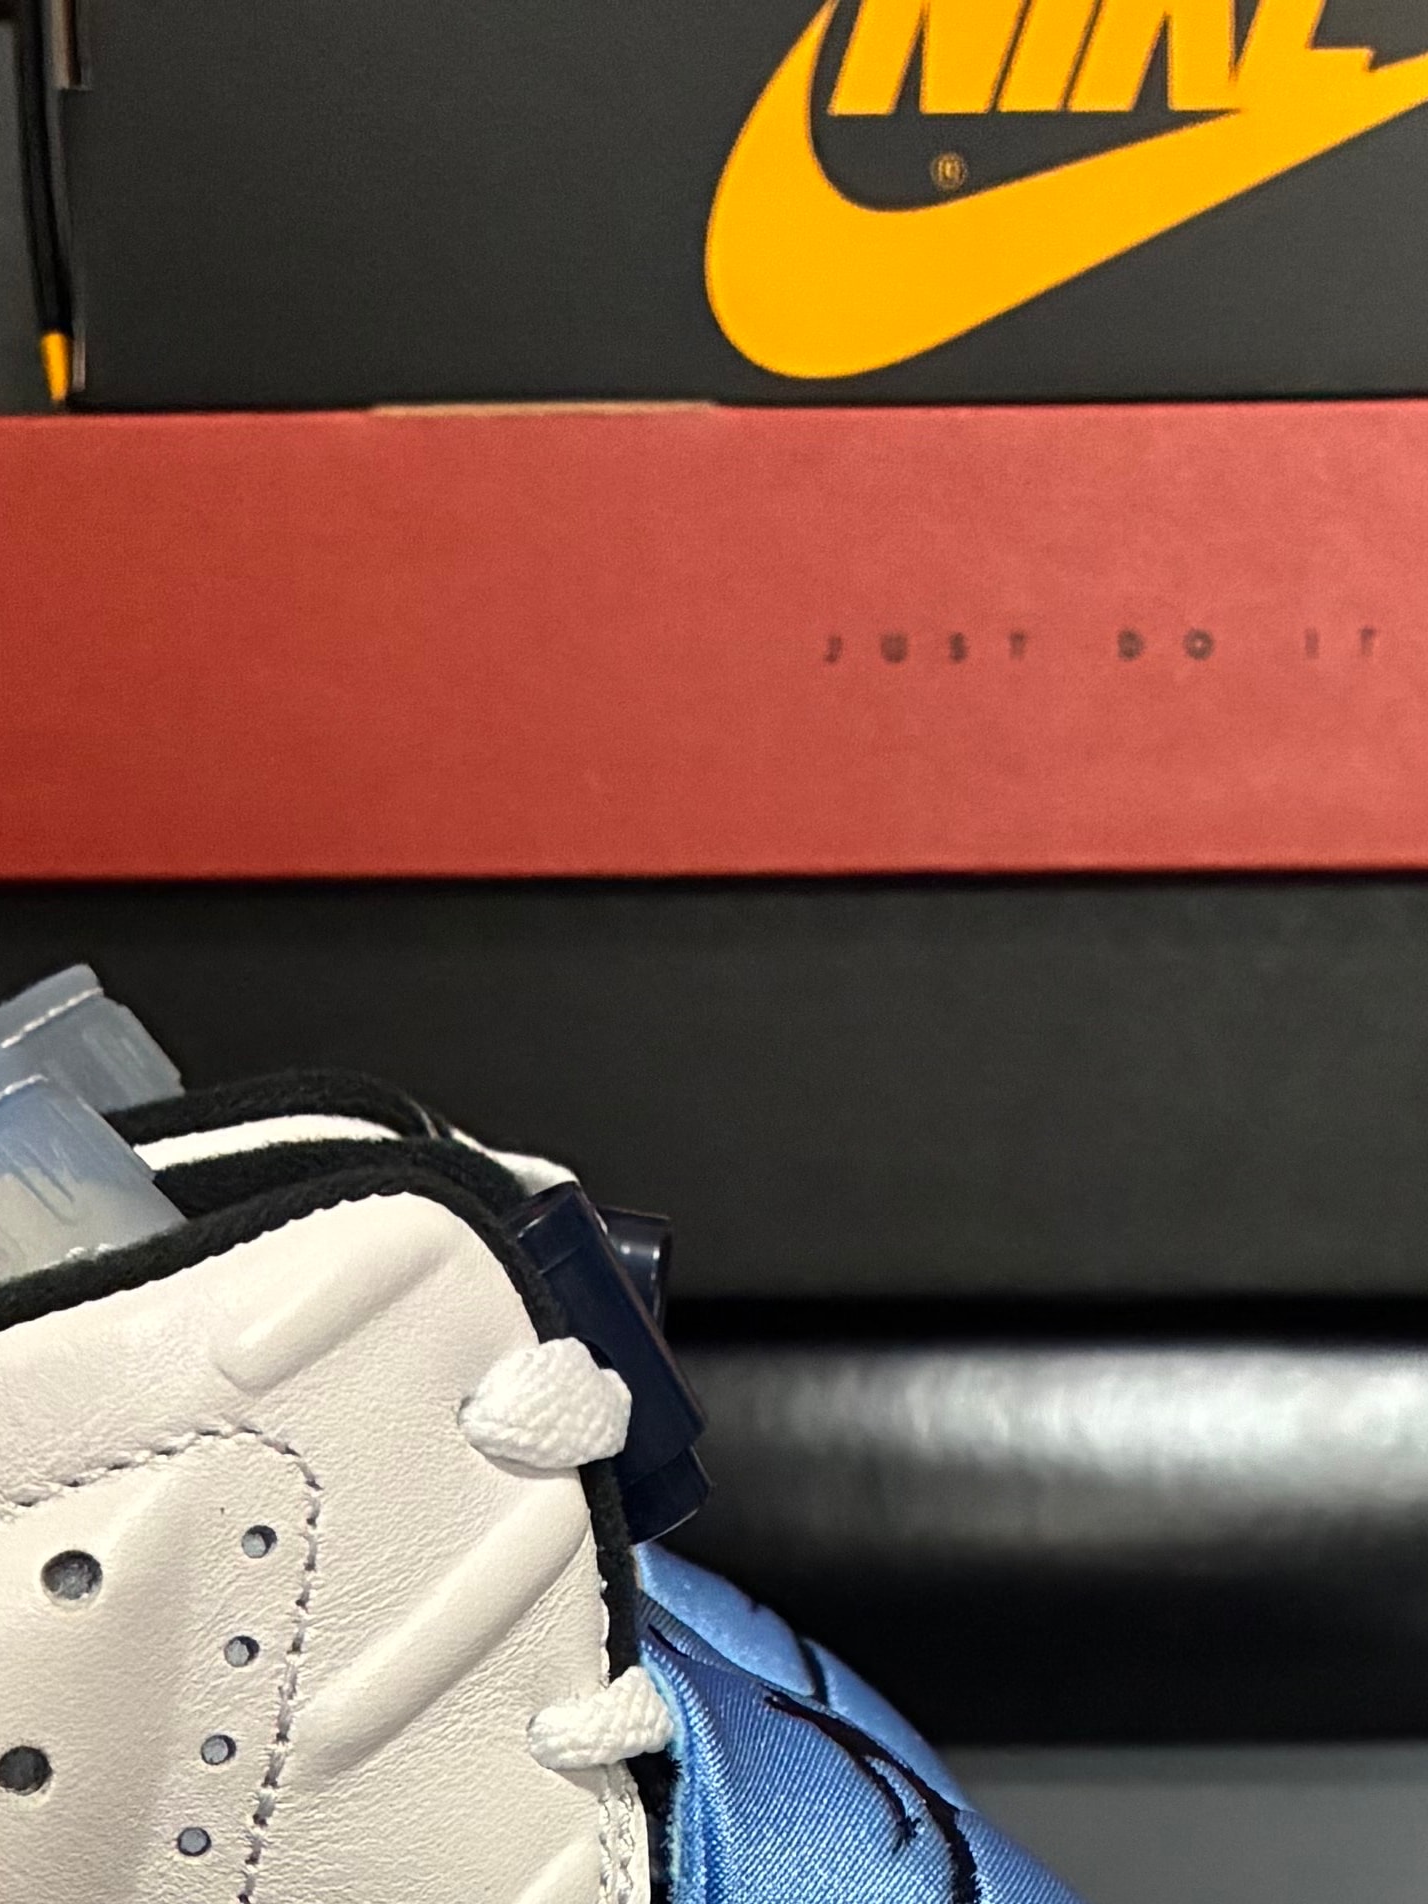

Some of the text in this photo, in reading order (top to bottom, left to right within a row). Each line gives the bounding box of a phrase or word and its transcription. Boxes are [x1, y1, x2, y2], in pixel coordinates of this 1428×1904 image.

[822, 624, 1379, 666] JUST DO IT
